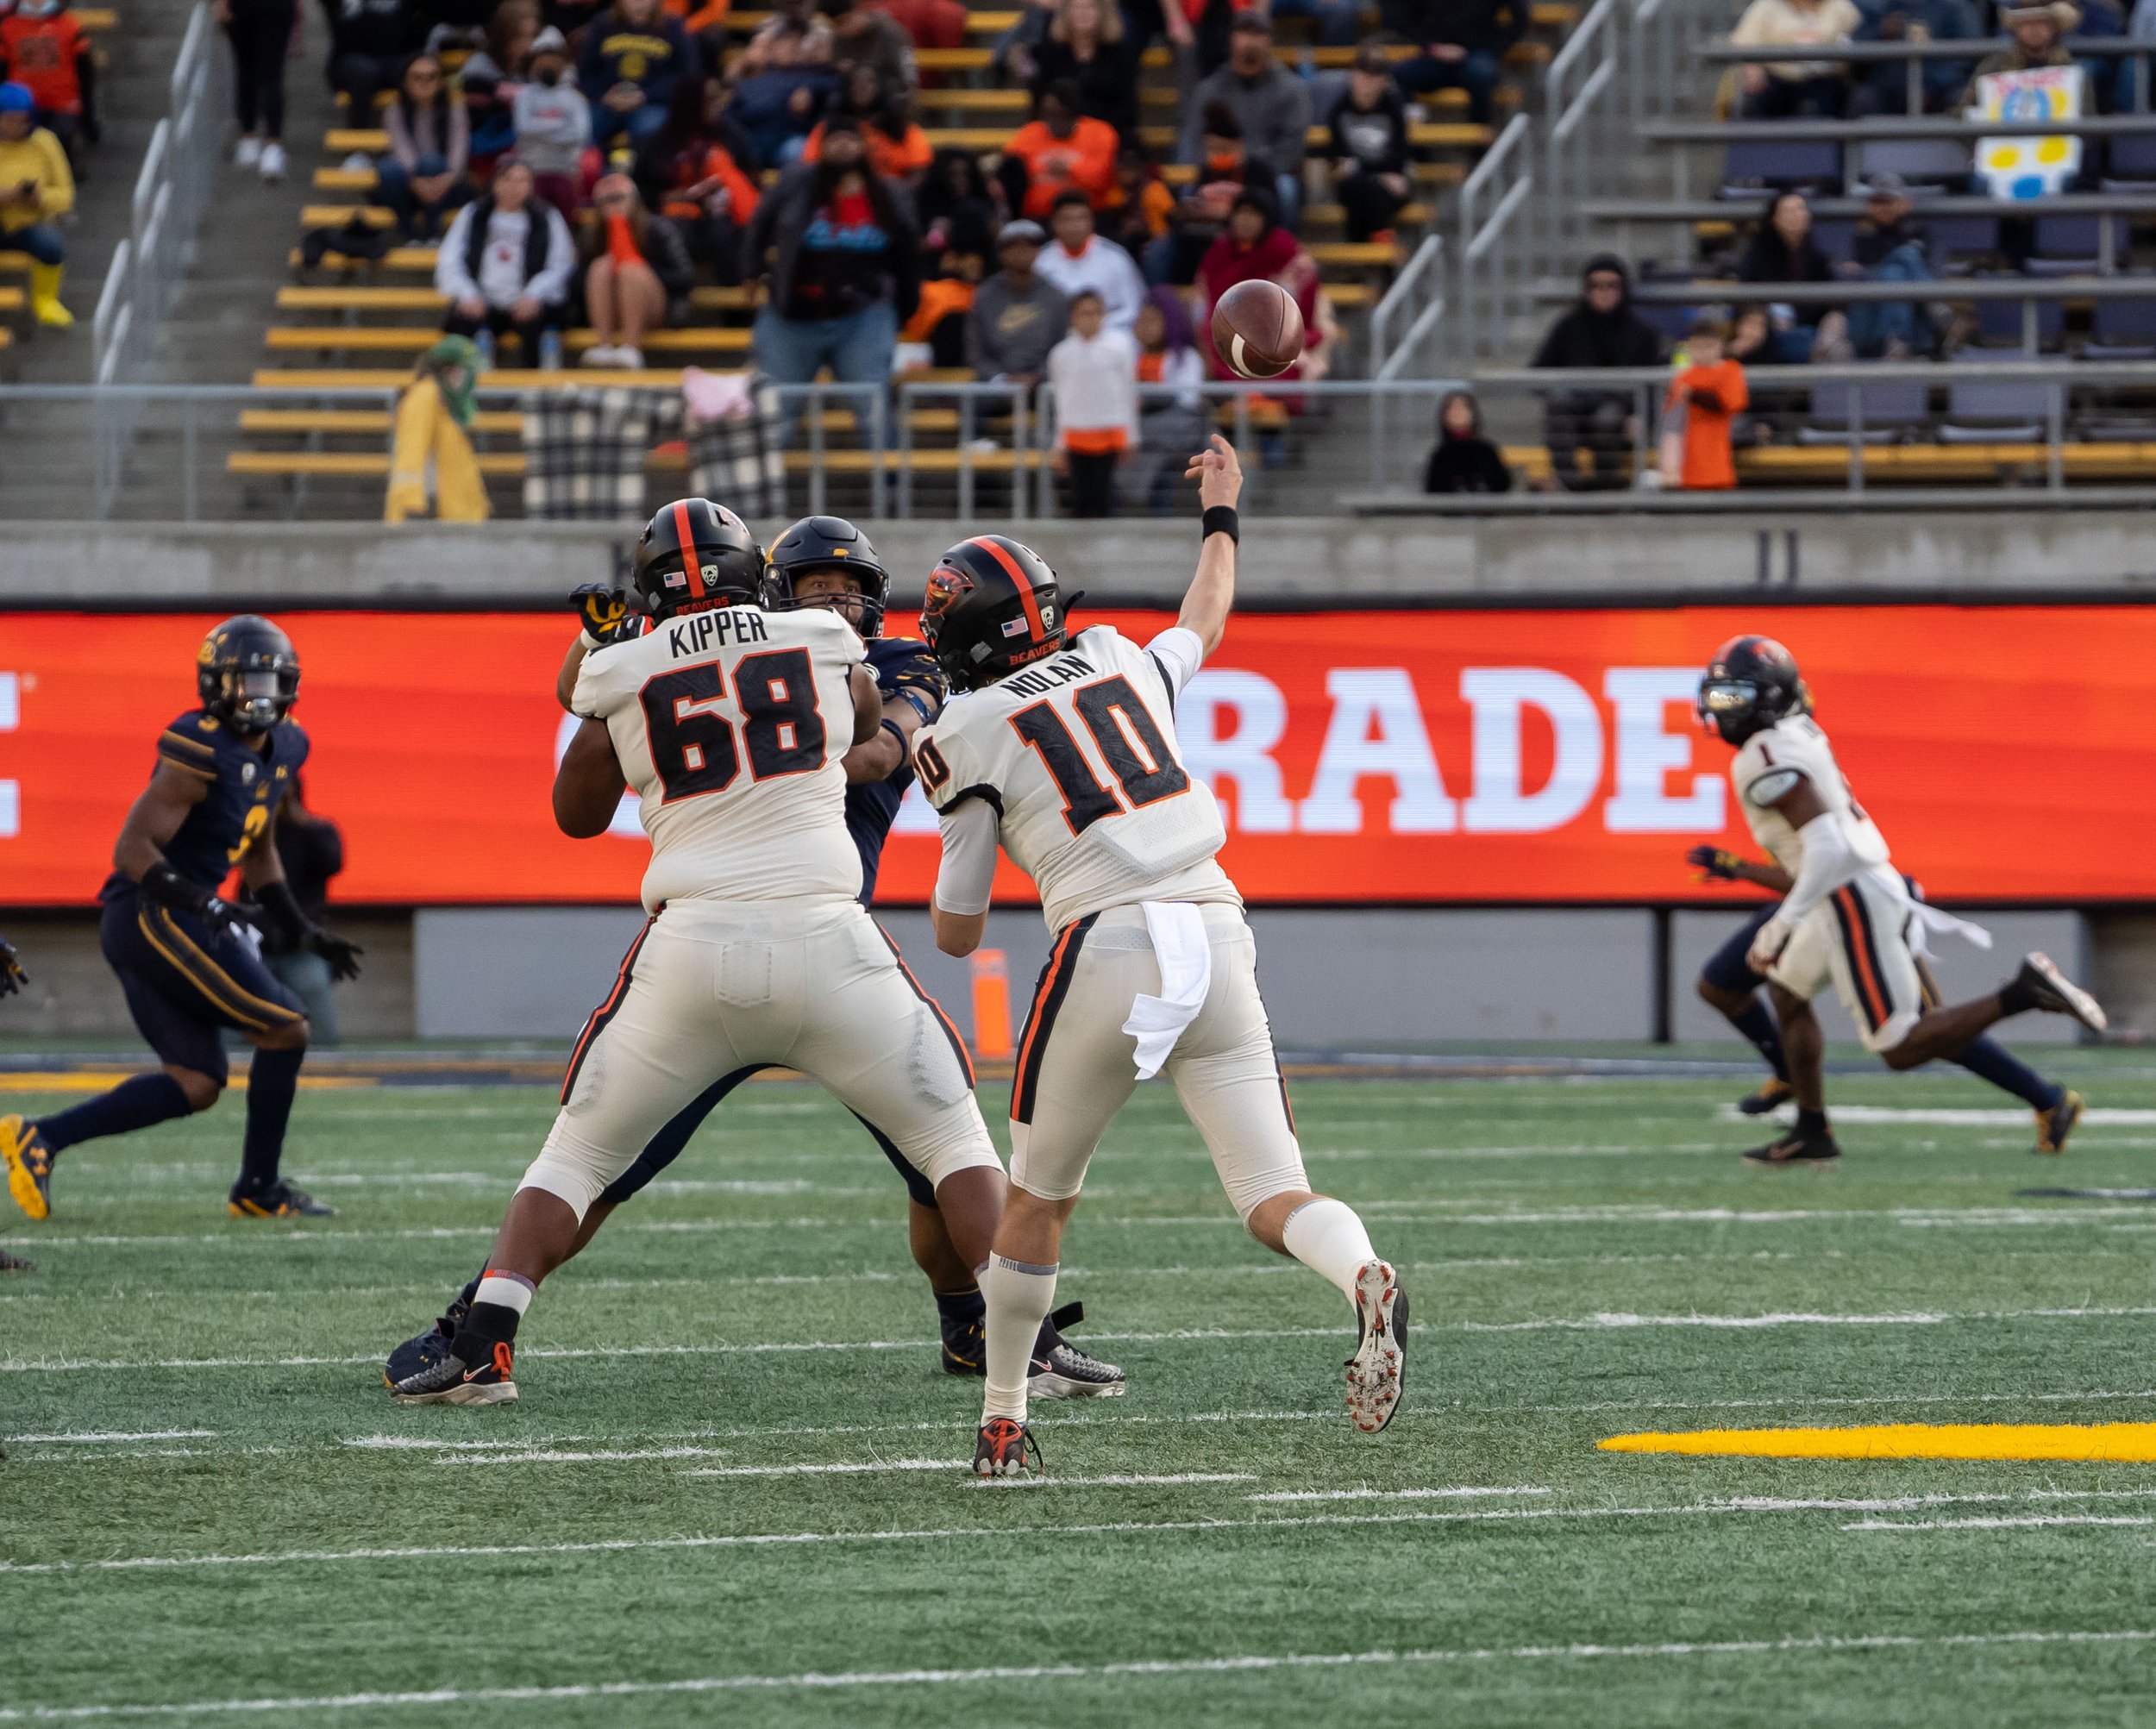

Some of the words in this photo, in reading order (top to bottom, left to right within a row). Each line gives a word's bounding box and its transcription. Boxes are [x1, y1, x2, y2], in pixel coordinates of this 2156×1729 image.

[676, 597, 730, 616] BEAVERS
[669, 611, 768, 659] KIPPER
[1009, 638, 1061, 667] BEAVERS
[1000, 655, 1096, 698] NOLAN
[638, 647, 828, 805] 68
[1007, 673, 1191, 838] 10
